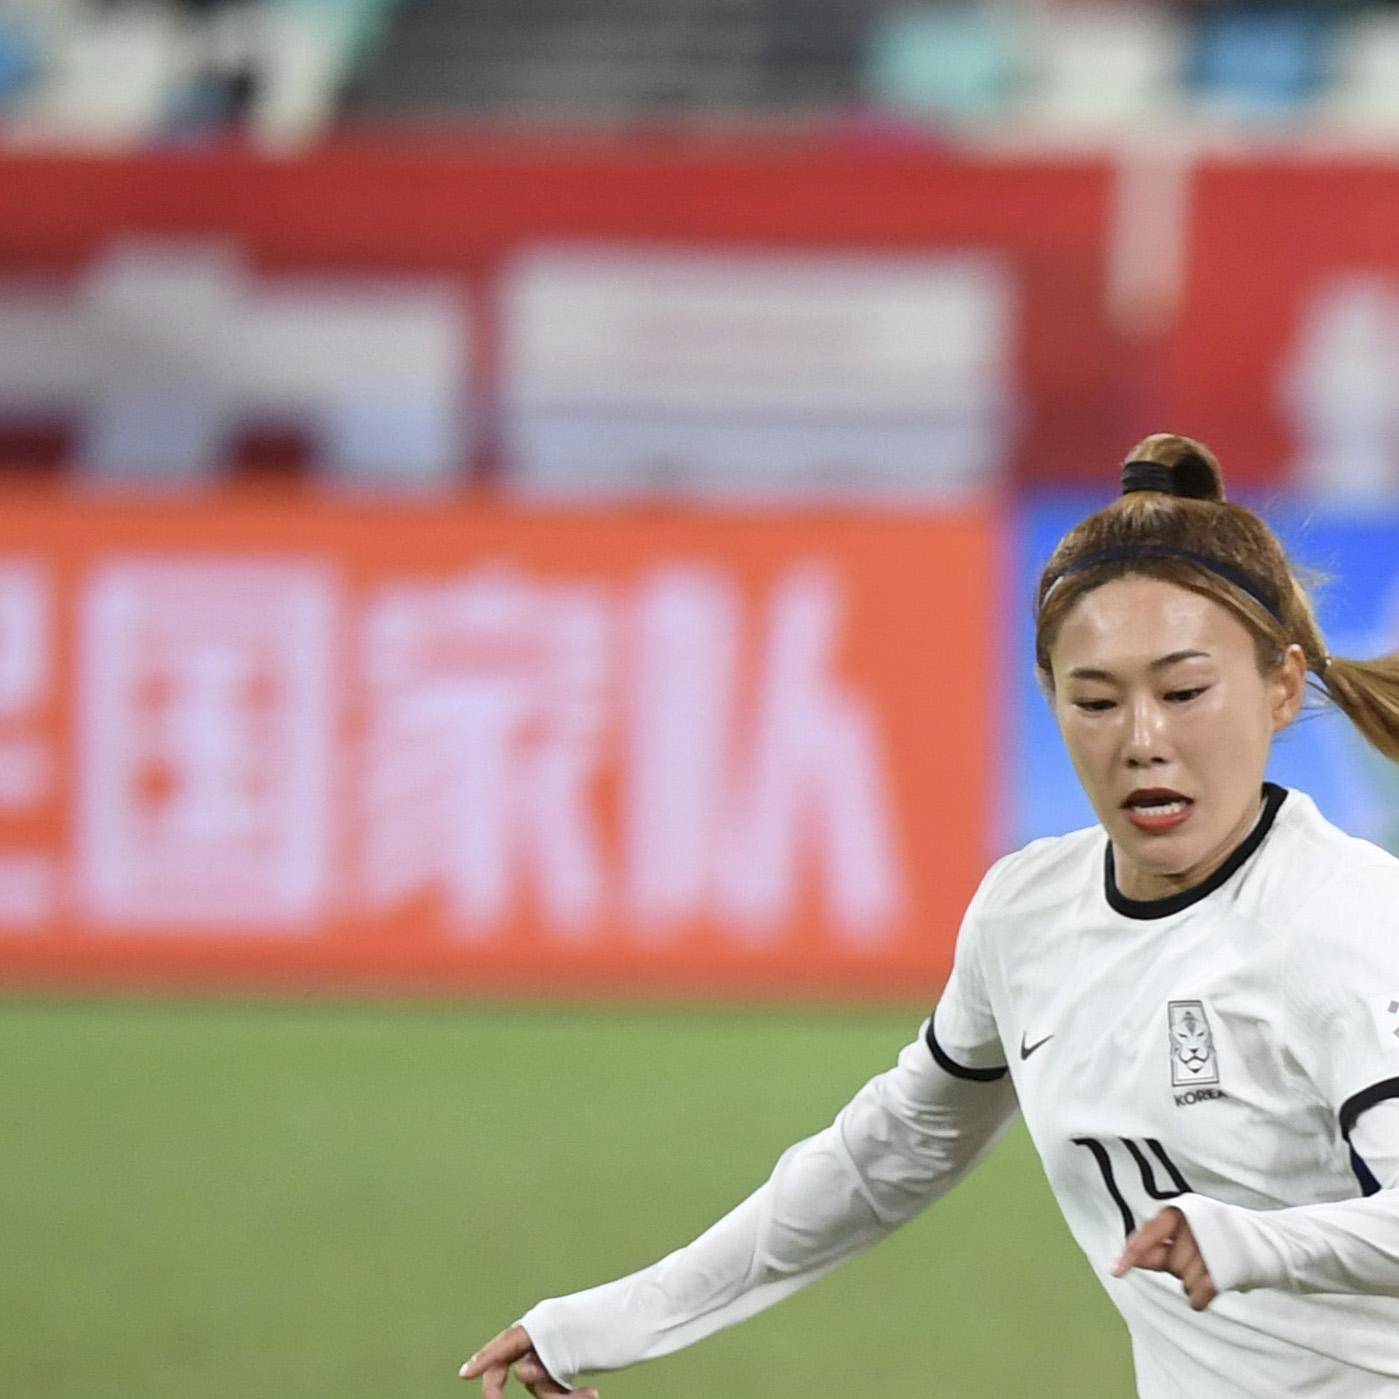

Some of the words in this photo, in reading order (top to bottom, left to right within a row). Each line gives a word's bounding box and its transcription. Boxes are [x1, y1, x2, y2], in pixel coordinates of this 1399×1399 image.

[0, 557, 908, 942] 国家队
[1071, 1137, 1195, 1237] 14
